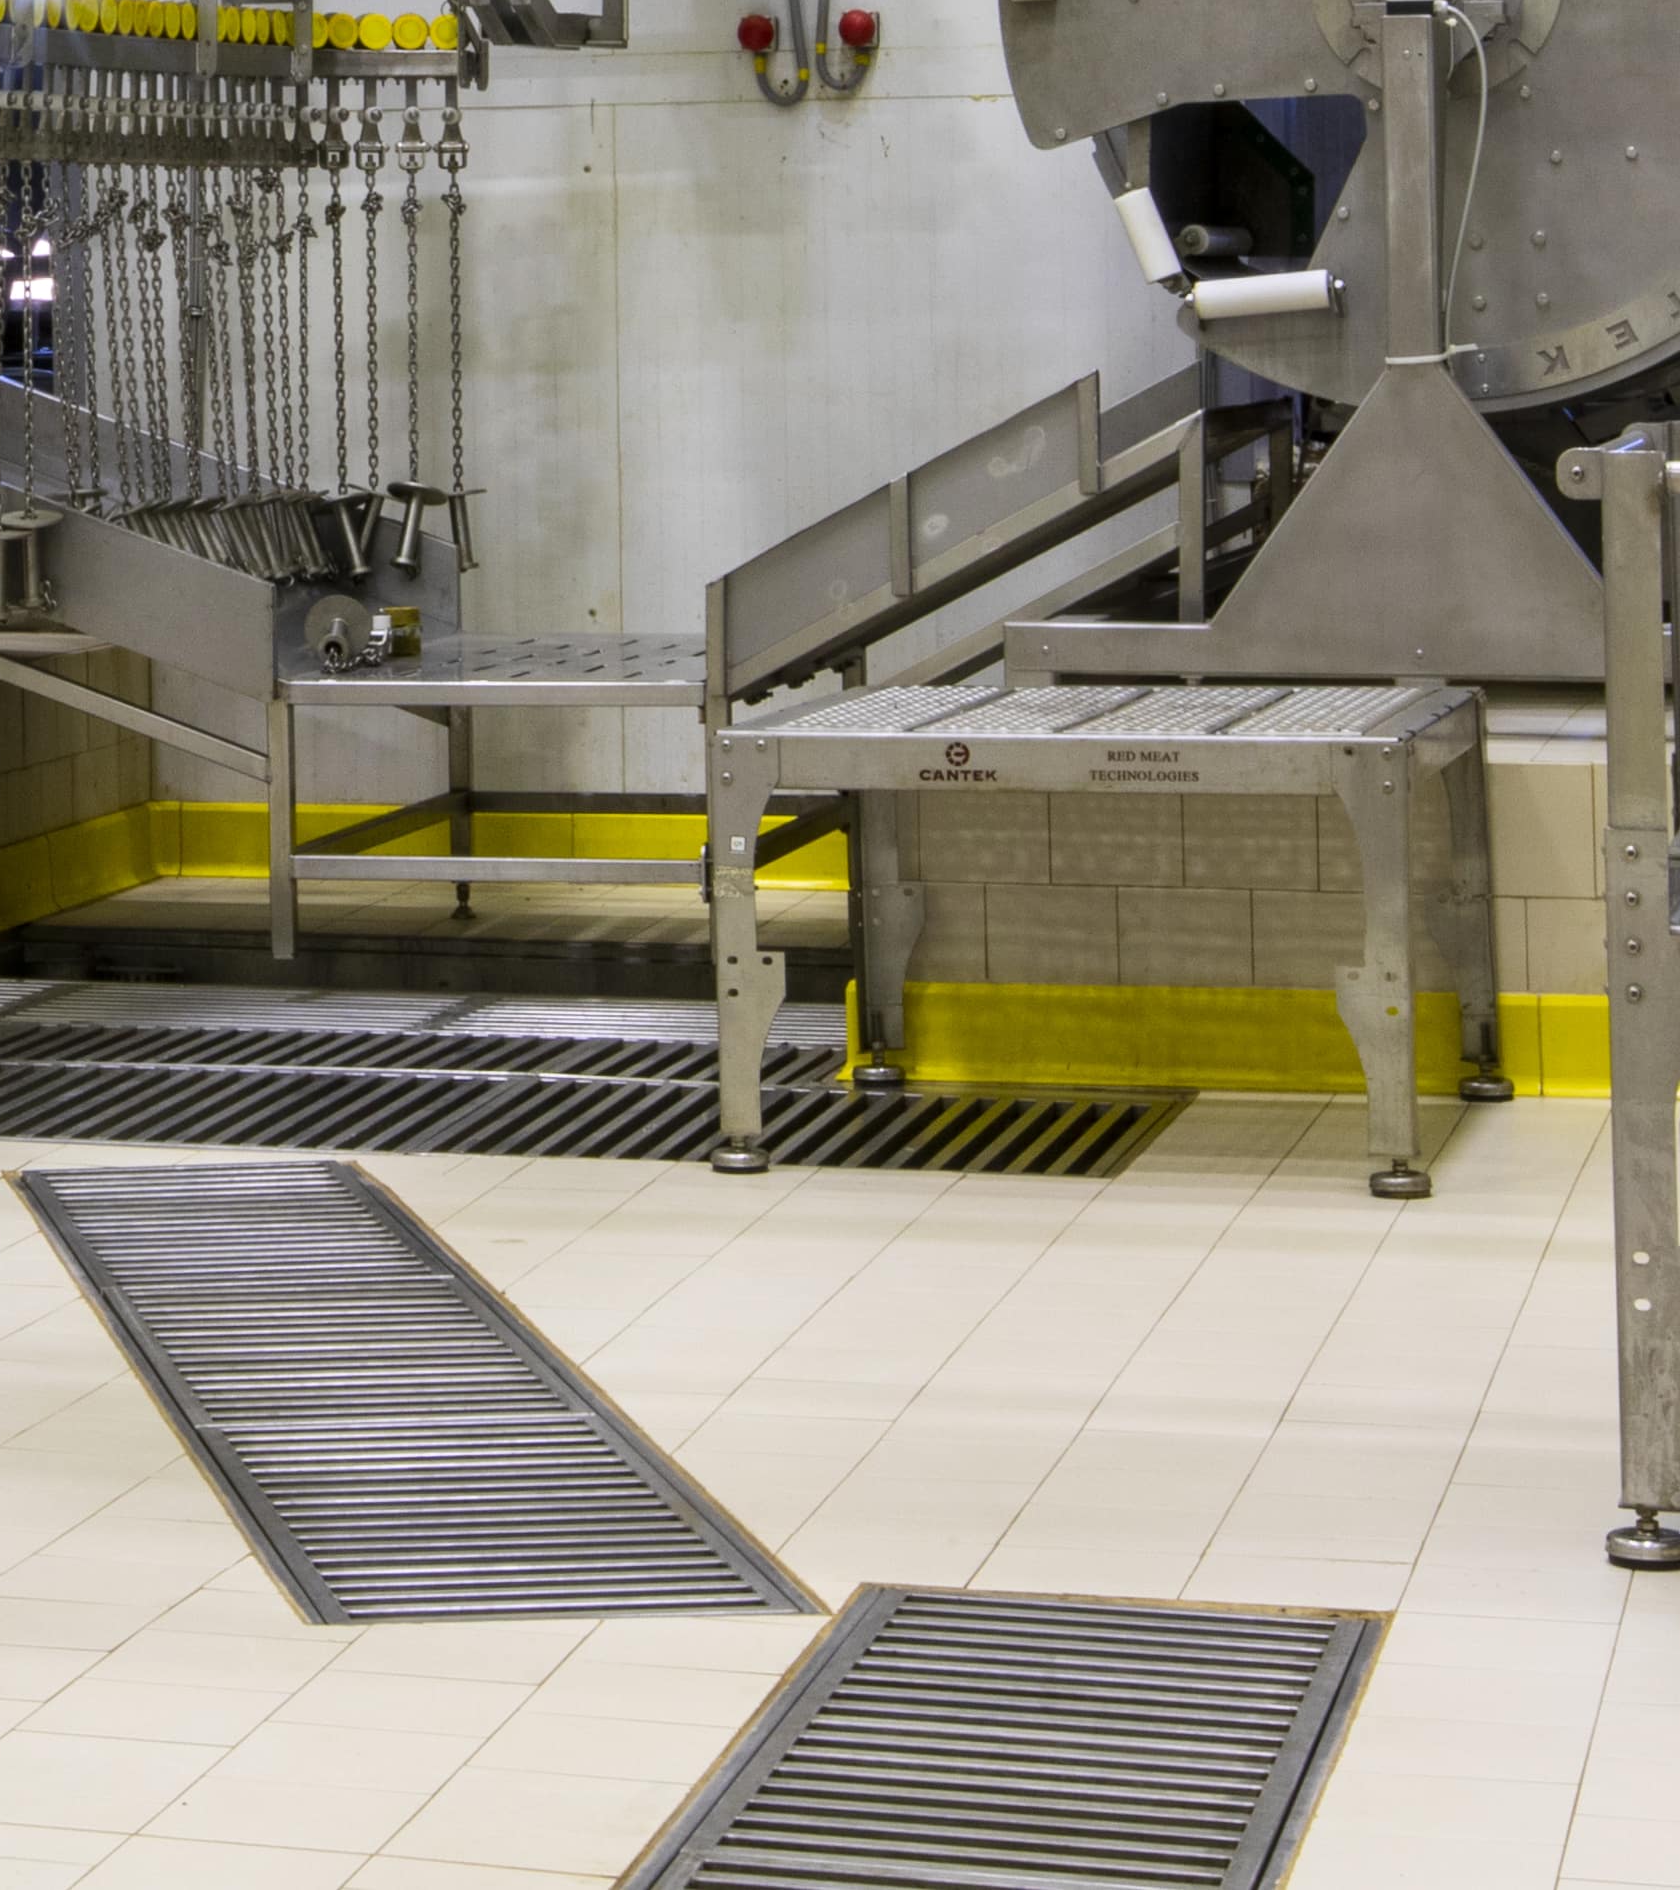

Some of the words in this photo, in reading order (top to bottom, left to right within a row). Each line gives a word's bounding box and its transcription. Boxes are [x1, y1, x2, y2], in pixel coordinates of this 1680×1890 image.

[1107, 750, 1136, 762] RED
[1140, 751, 1180, 763] MEAT
[919, 769, 997, 782] CANTEK
[1090, 770, 1200, 782] TECHNOLOGIES
